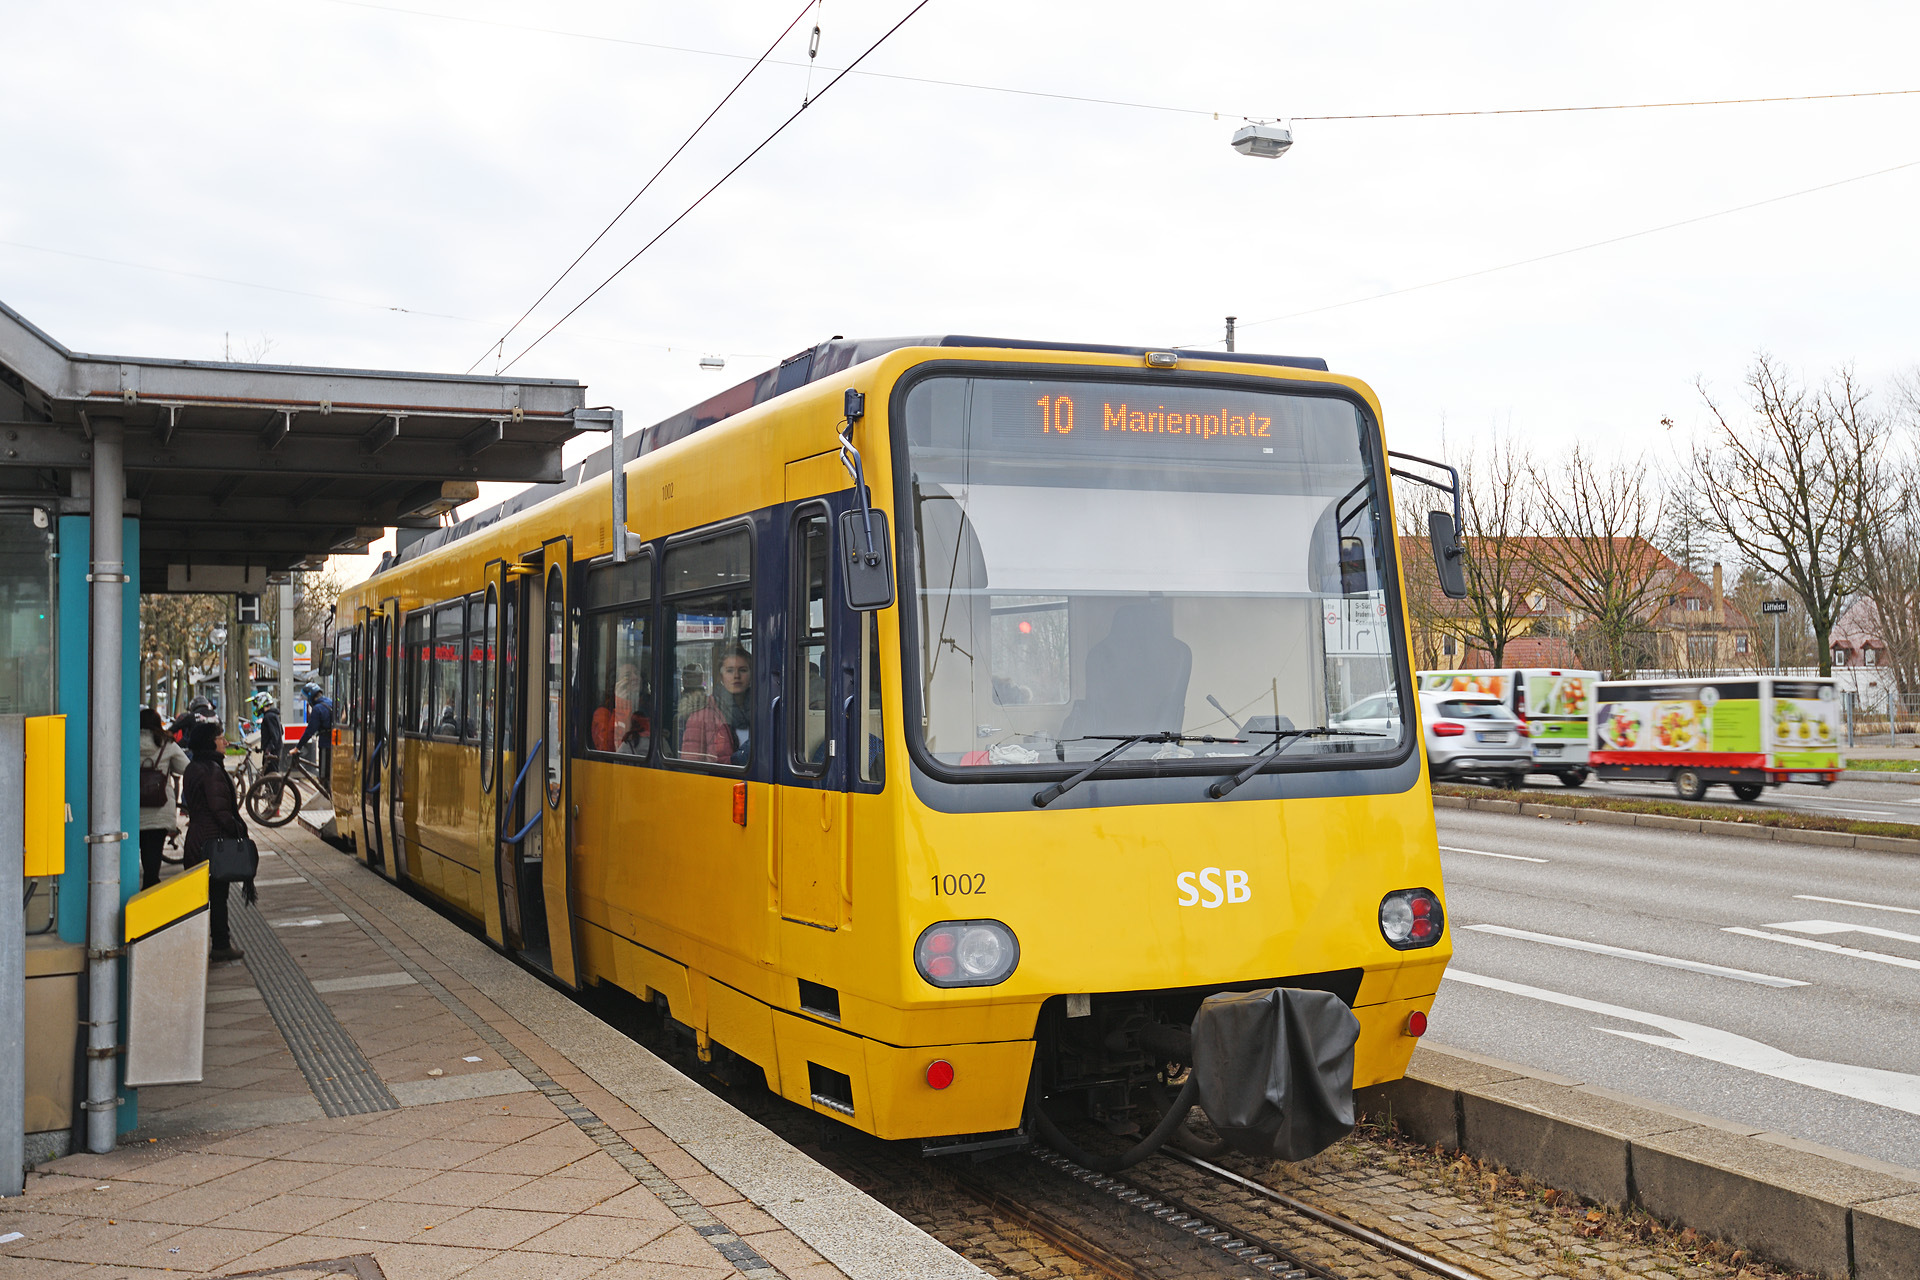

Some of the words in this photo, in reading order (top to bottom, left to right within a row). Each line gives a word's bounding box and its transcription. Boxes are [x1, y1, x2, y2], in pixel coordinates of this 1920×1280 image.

[1037, 395, 1074, 434] 10
[1104, 403, 1271, 439] Marienplatz
[662, 482, 674, 501] 1002
[238, 597, 259, 621] H
[931, 873, 987, 896] 1002
[1176, 866, 1252, 909] SSB
